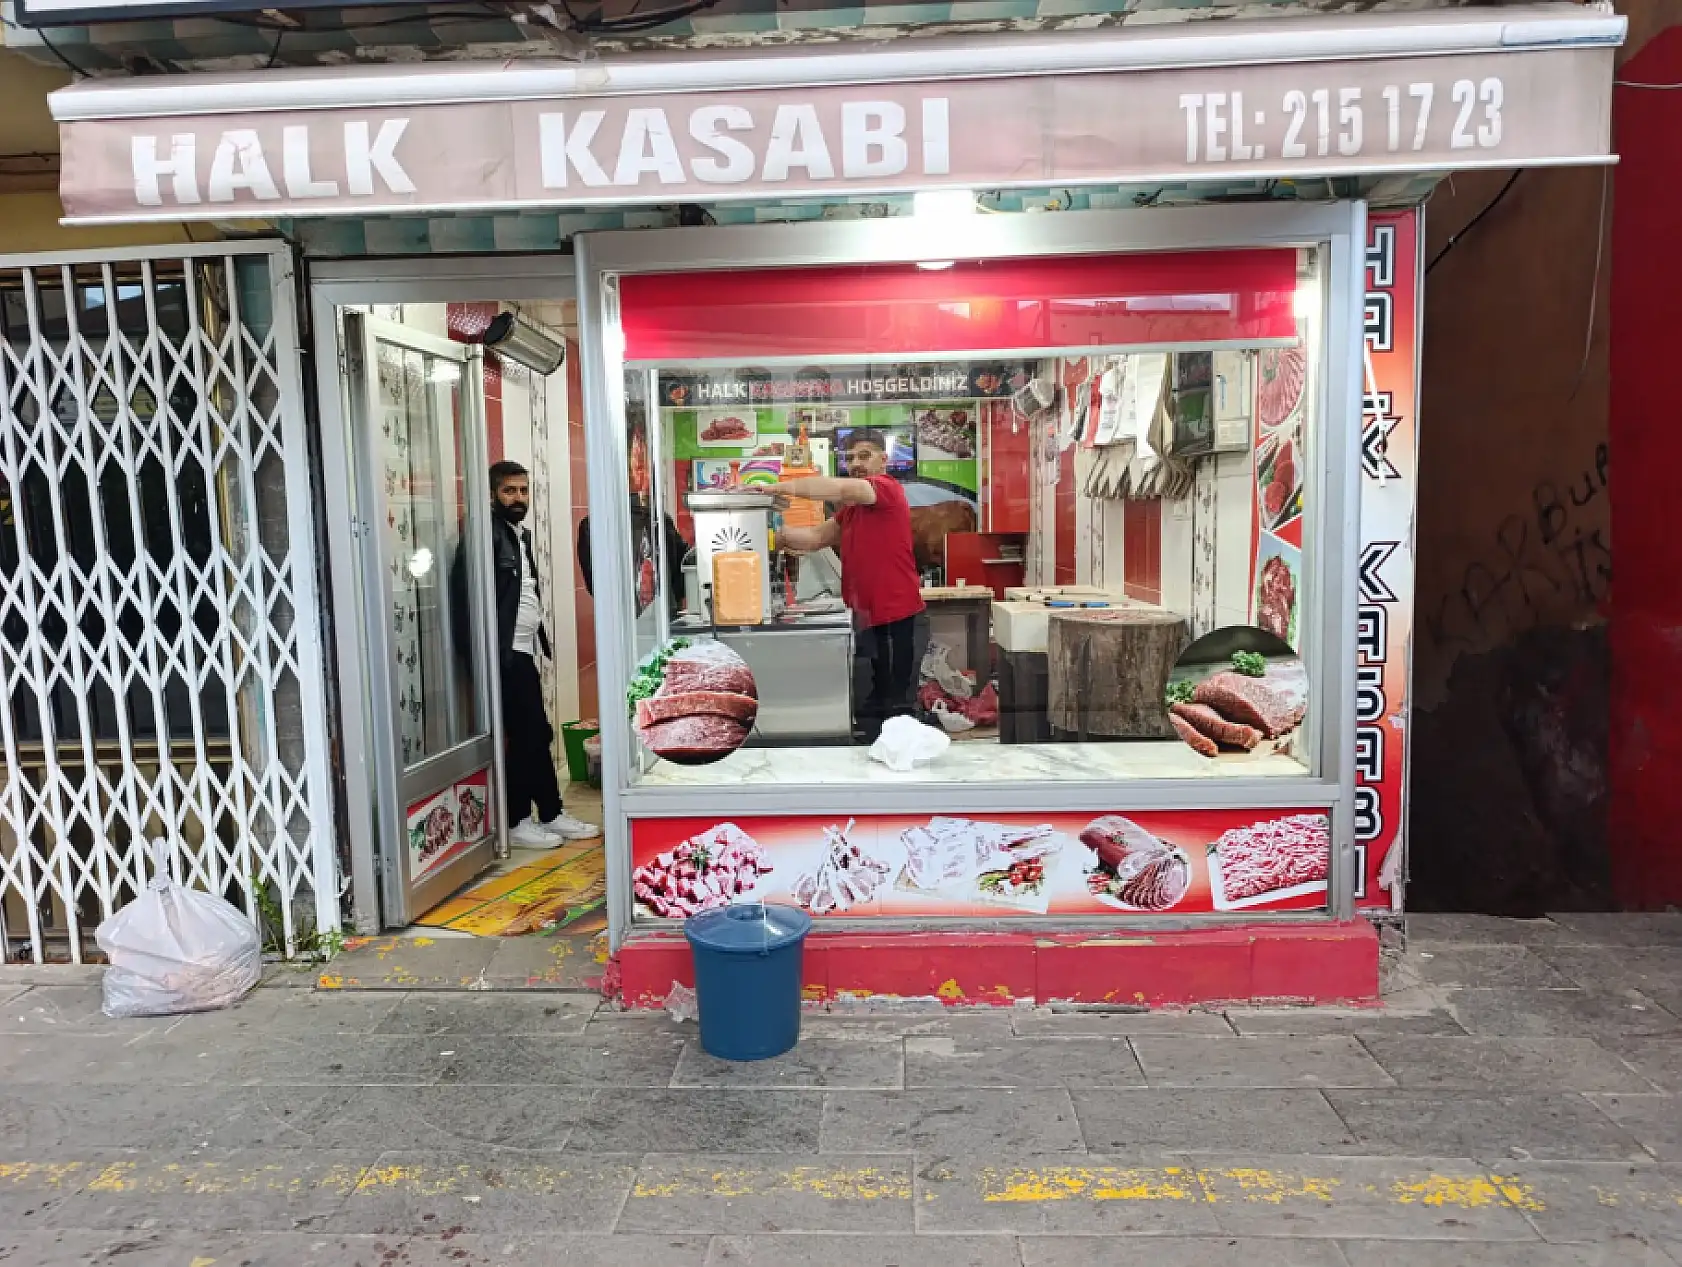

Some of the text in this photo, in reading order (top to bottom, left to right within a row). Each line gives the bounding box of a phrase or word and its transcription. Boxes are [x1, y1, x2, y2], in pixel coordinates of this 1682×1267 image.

[130, 97, 951, 207] HALK KASABI
[1179, 77, 1506, 164] TEL: 215 17 23
[697, 382, 748, 400] HALK
